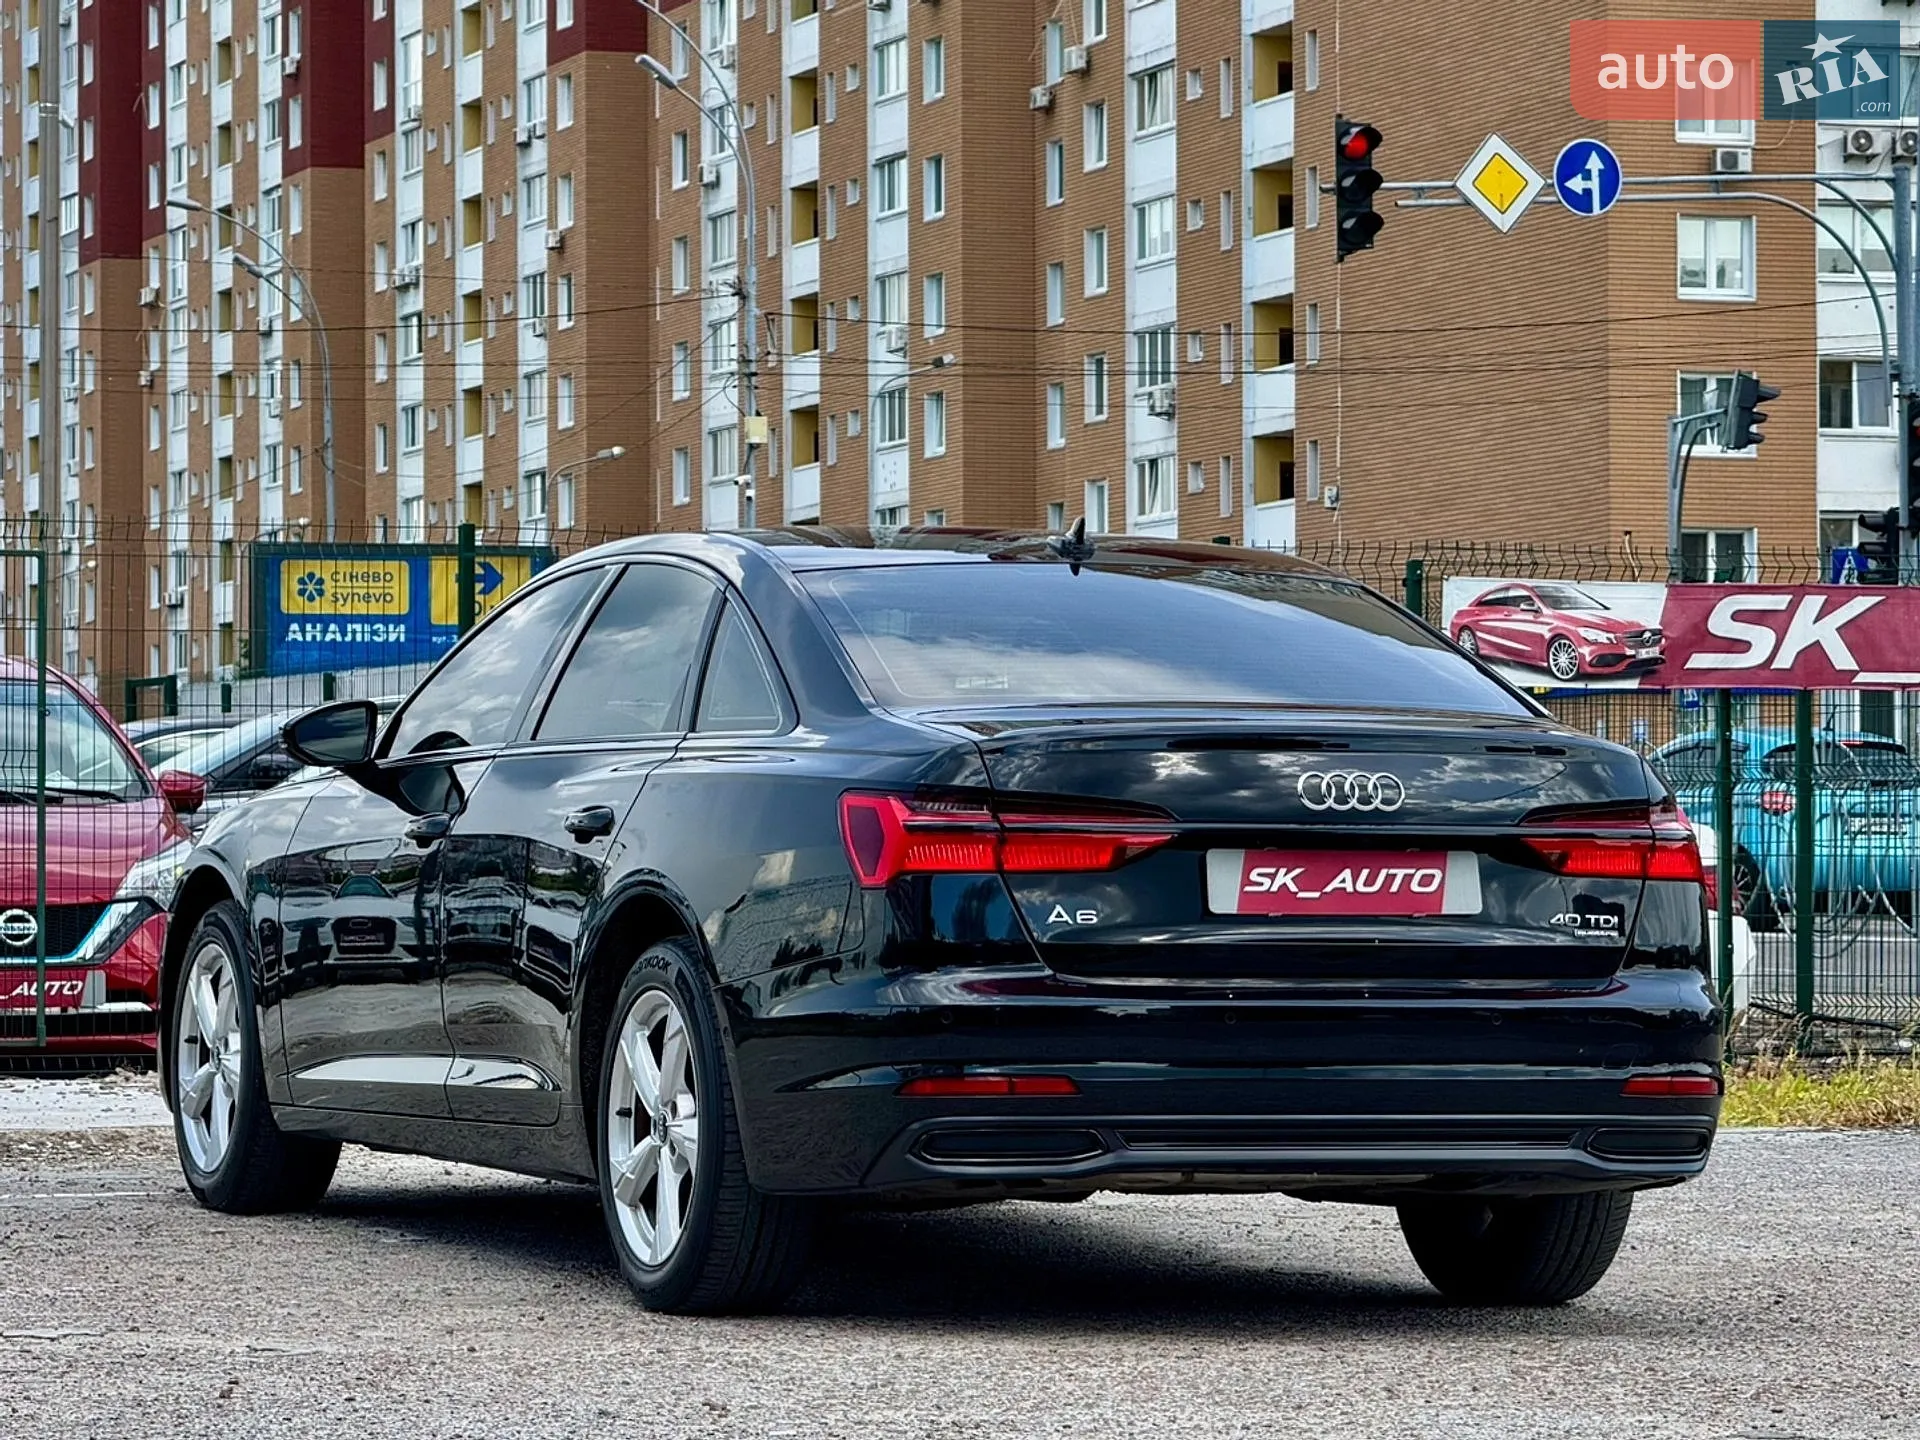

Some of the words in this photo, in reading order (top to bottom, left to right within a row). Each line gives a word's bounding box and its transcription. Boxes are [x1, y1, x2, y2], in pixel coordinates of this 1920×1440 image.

[330, 591, 394, 607] synevo
[285, 622, 405, 643] АНАЛІЗИ
[1243, 867, 1443, 898] SK_AUTO
[1045, 904, 1098, 925] A6
[1549, 913, 1581, 927] 40
[1585, 914, 1619, 928] TDI
